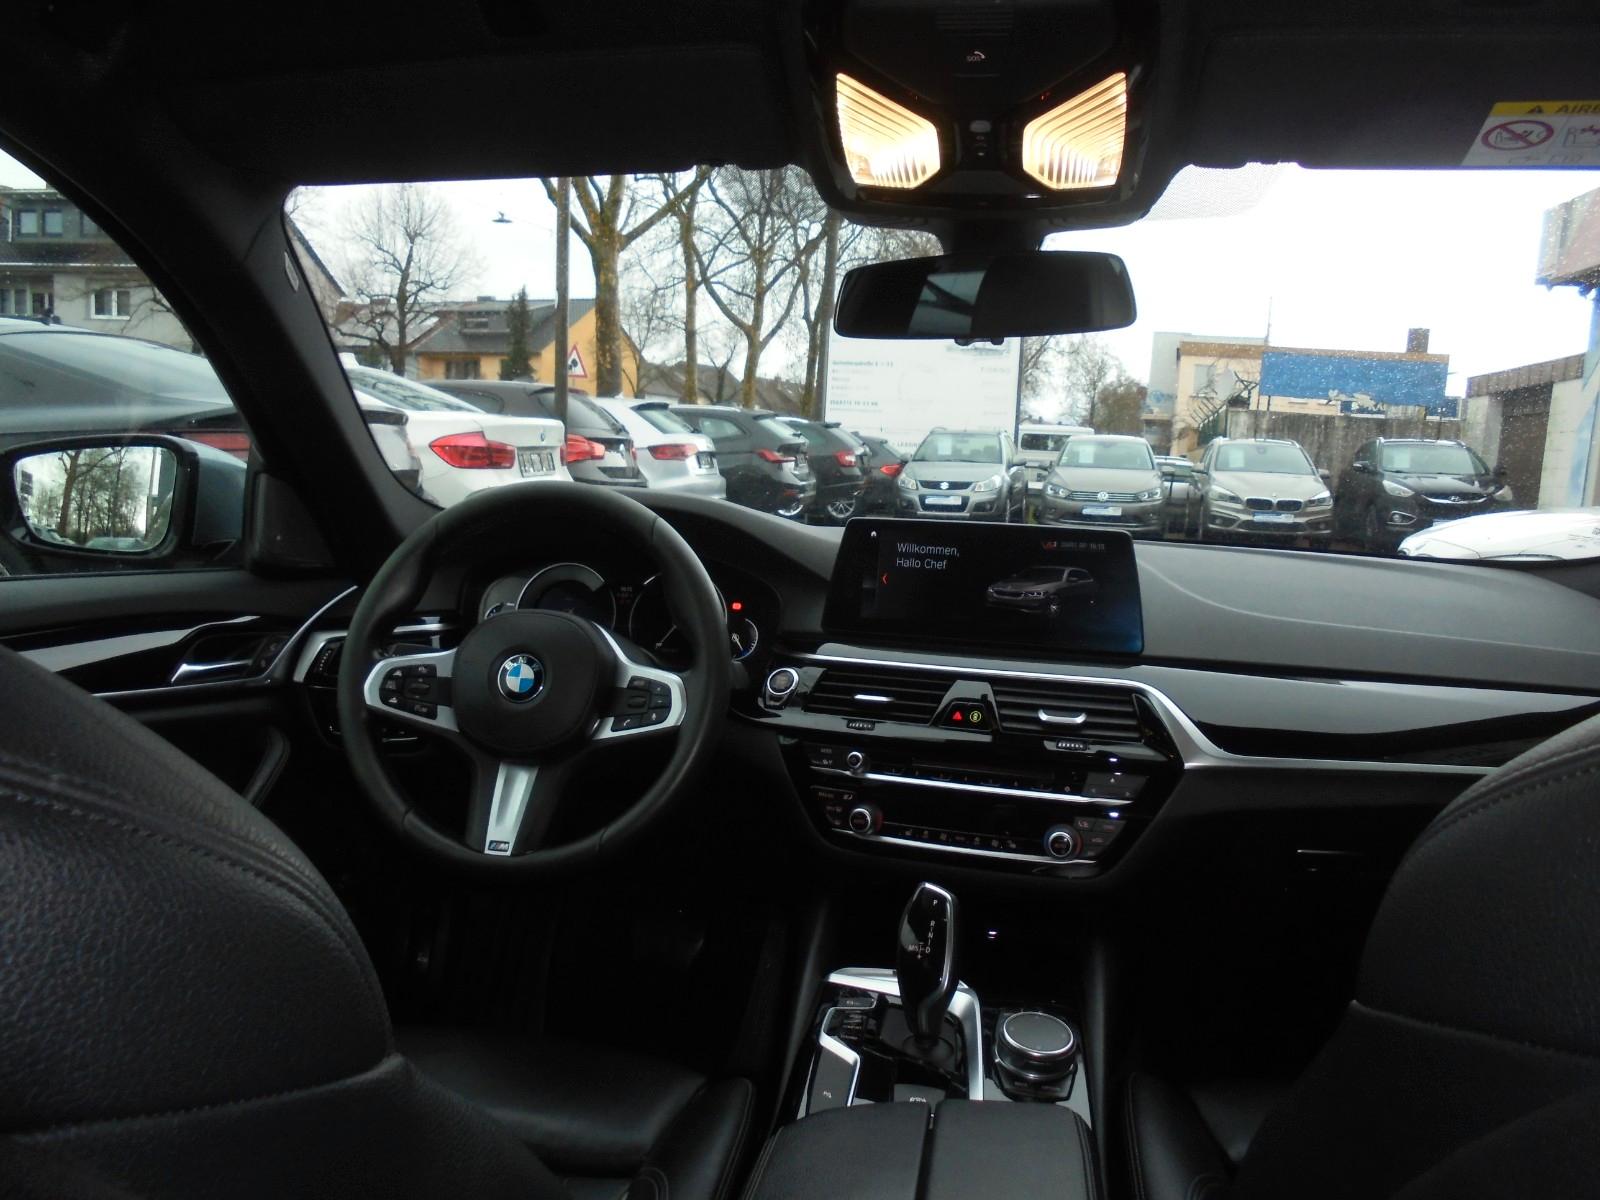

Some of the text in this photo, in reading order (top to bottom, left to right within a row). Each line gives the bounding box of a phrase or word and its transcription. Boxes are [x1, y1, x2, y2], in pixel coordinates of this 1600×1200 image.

[896, 541, 960, 557] Willkommen,
[896, 557, 949, 570] Hallo Chef
[504, 655, 541, 672] BMW
